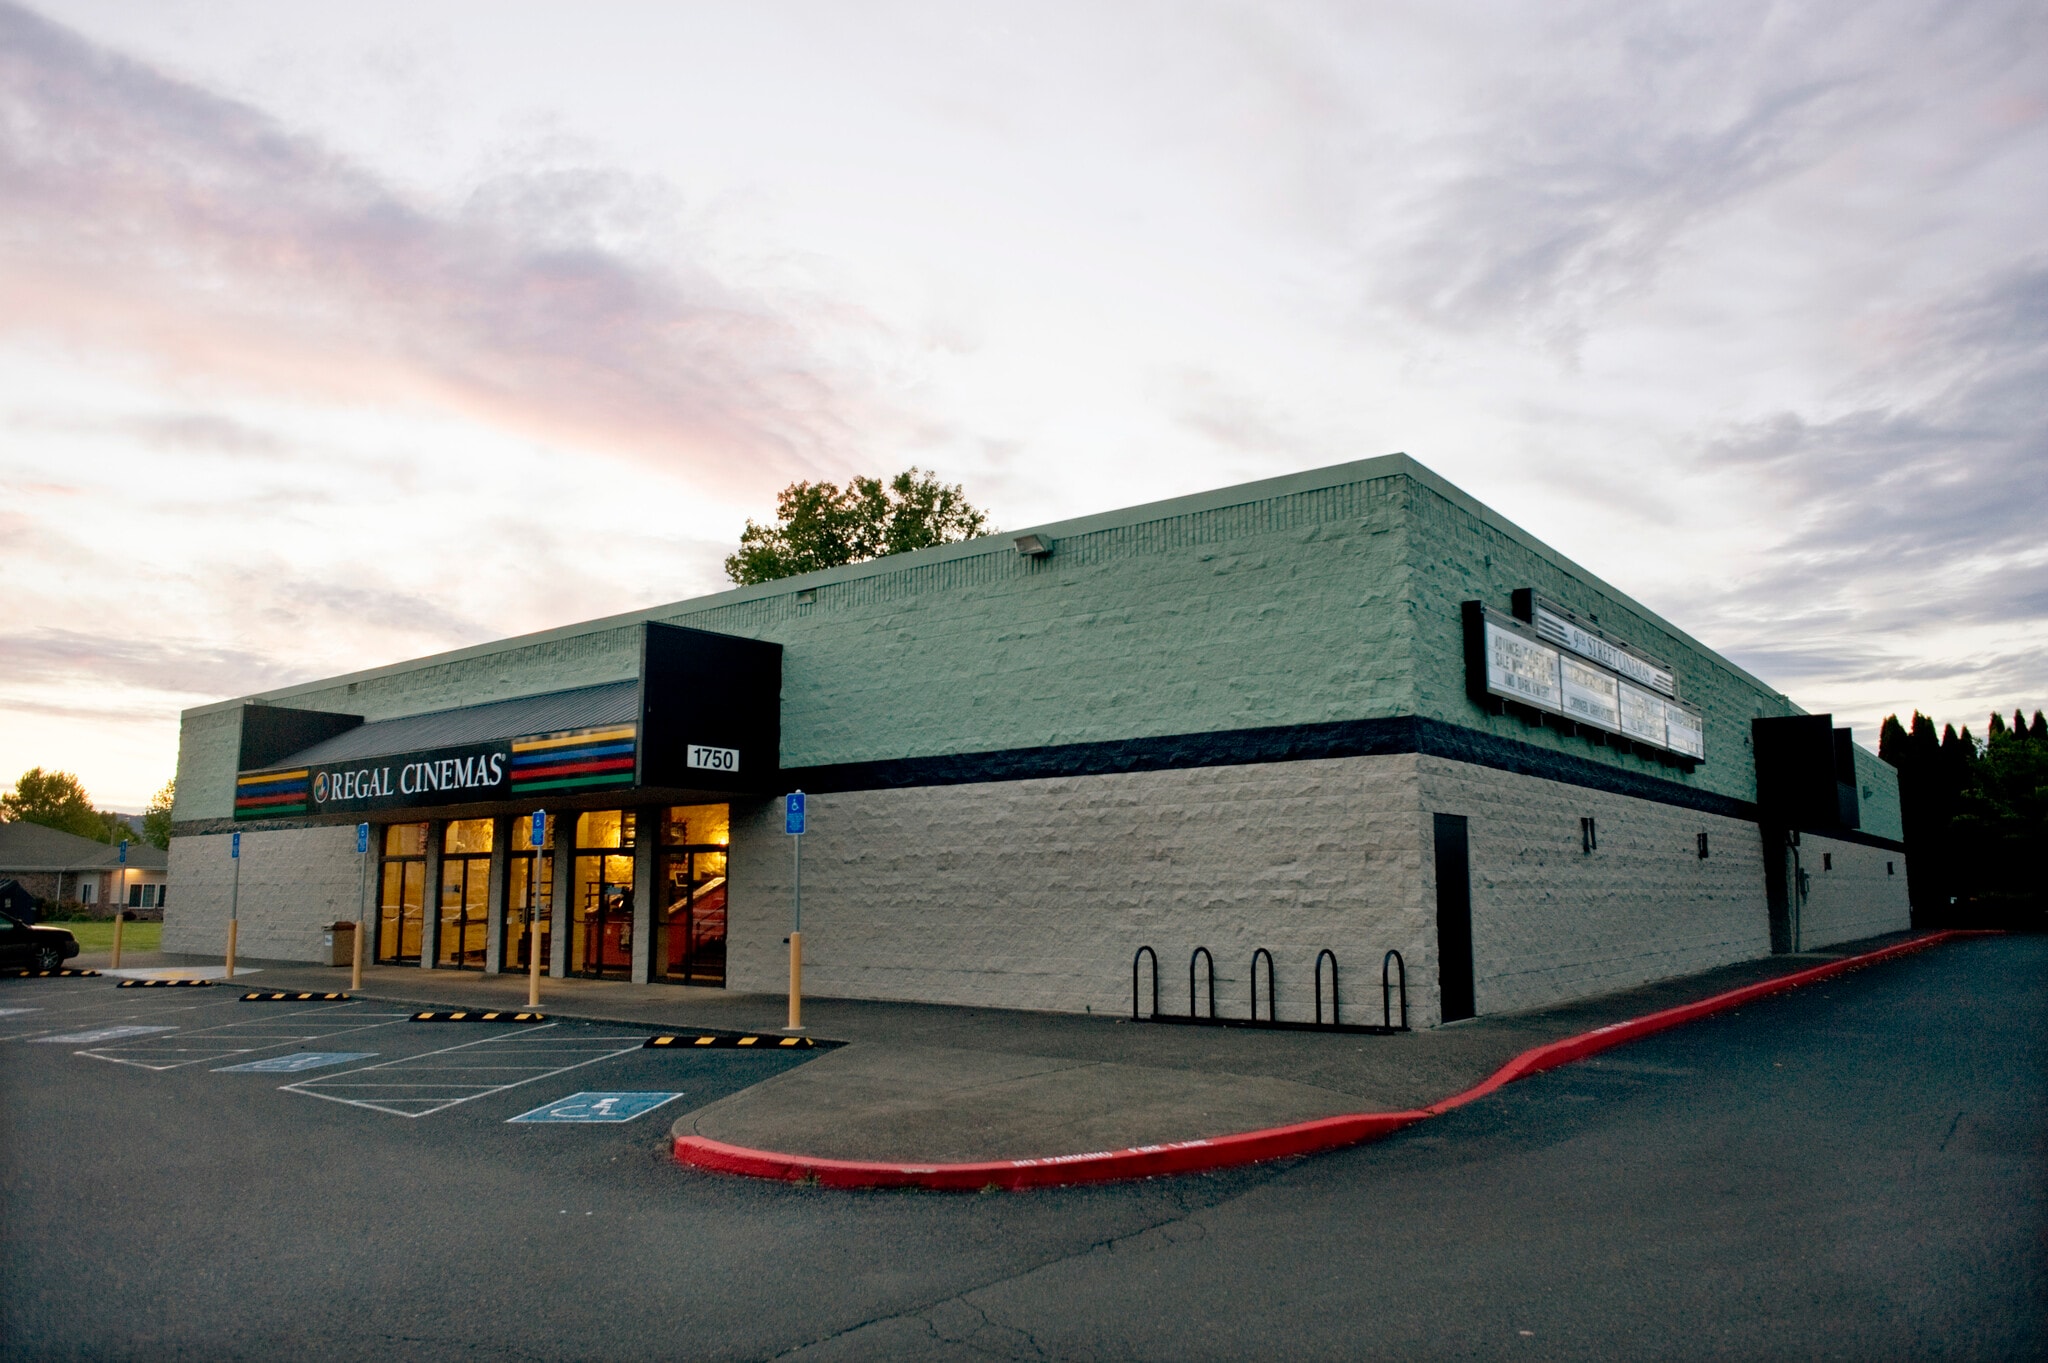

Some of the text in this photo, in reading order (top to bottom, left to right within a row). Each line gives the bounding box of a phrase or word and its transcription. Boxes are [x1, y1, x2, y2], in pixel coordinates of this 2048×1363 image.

[1588, 636, 1618, 667] STREET
[1620, 651, 1650, 683] CINEMAS
[694, 748, 733, 769] 1750
[331, 753, 502, 800] REGAL CINEMAS
[1042, 1152, 1112, 1164] PARKING
[1128, 1145, 1167, 1154] FIRE
[1168, 1140, 1214, 1148] LANE
